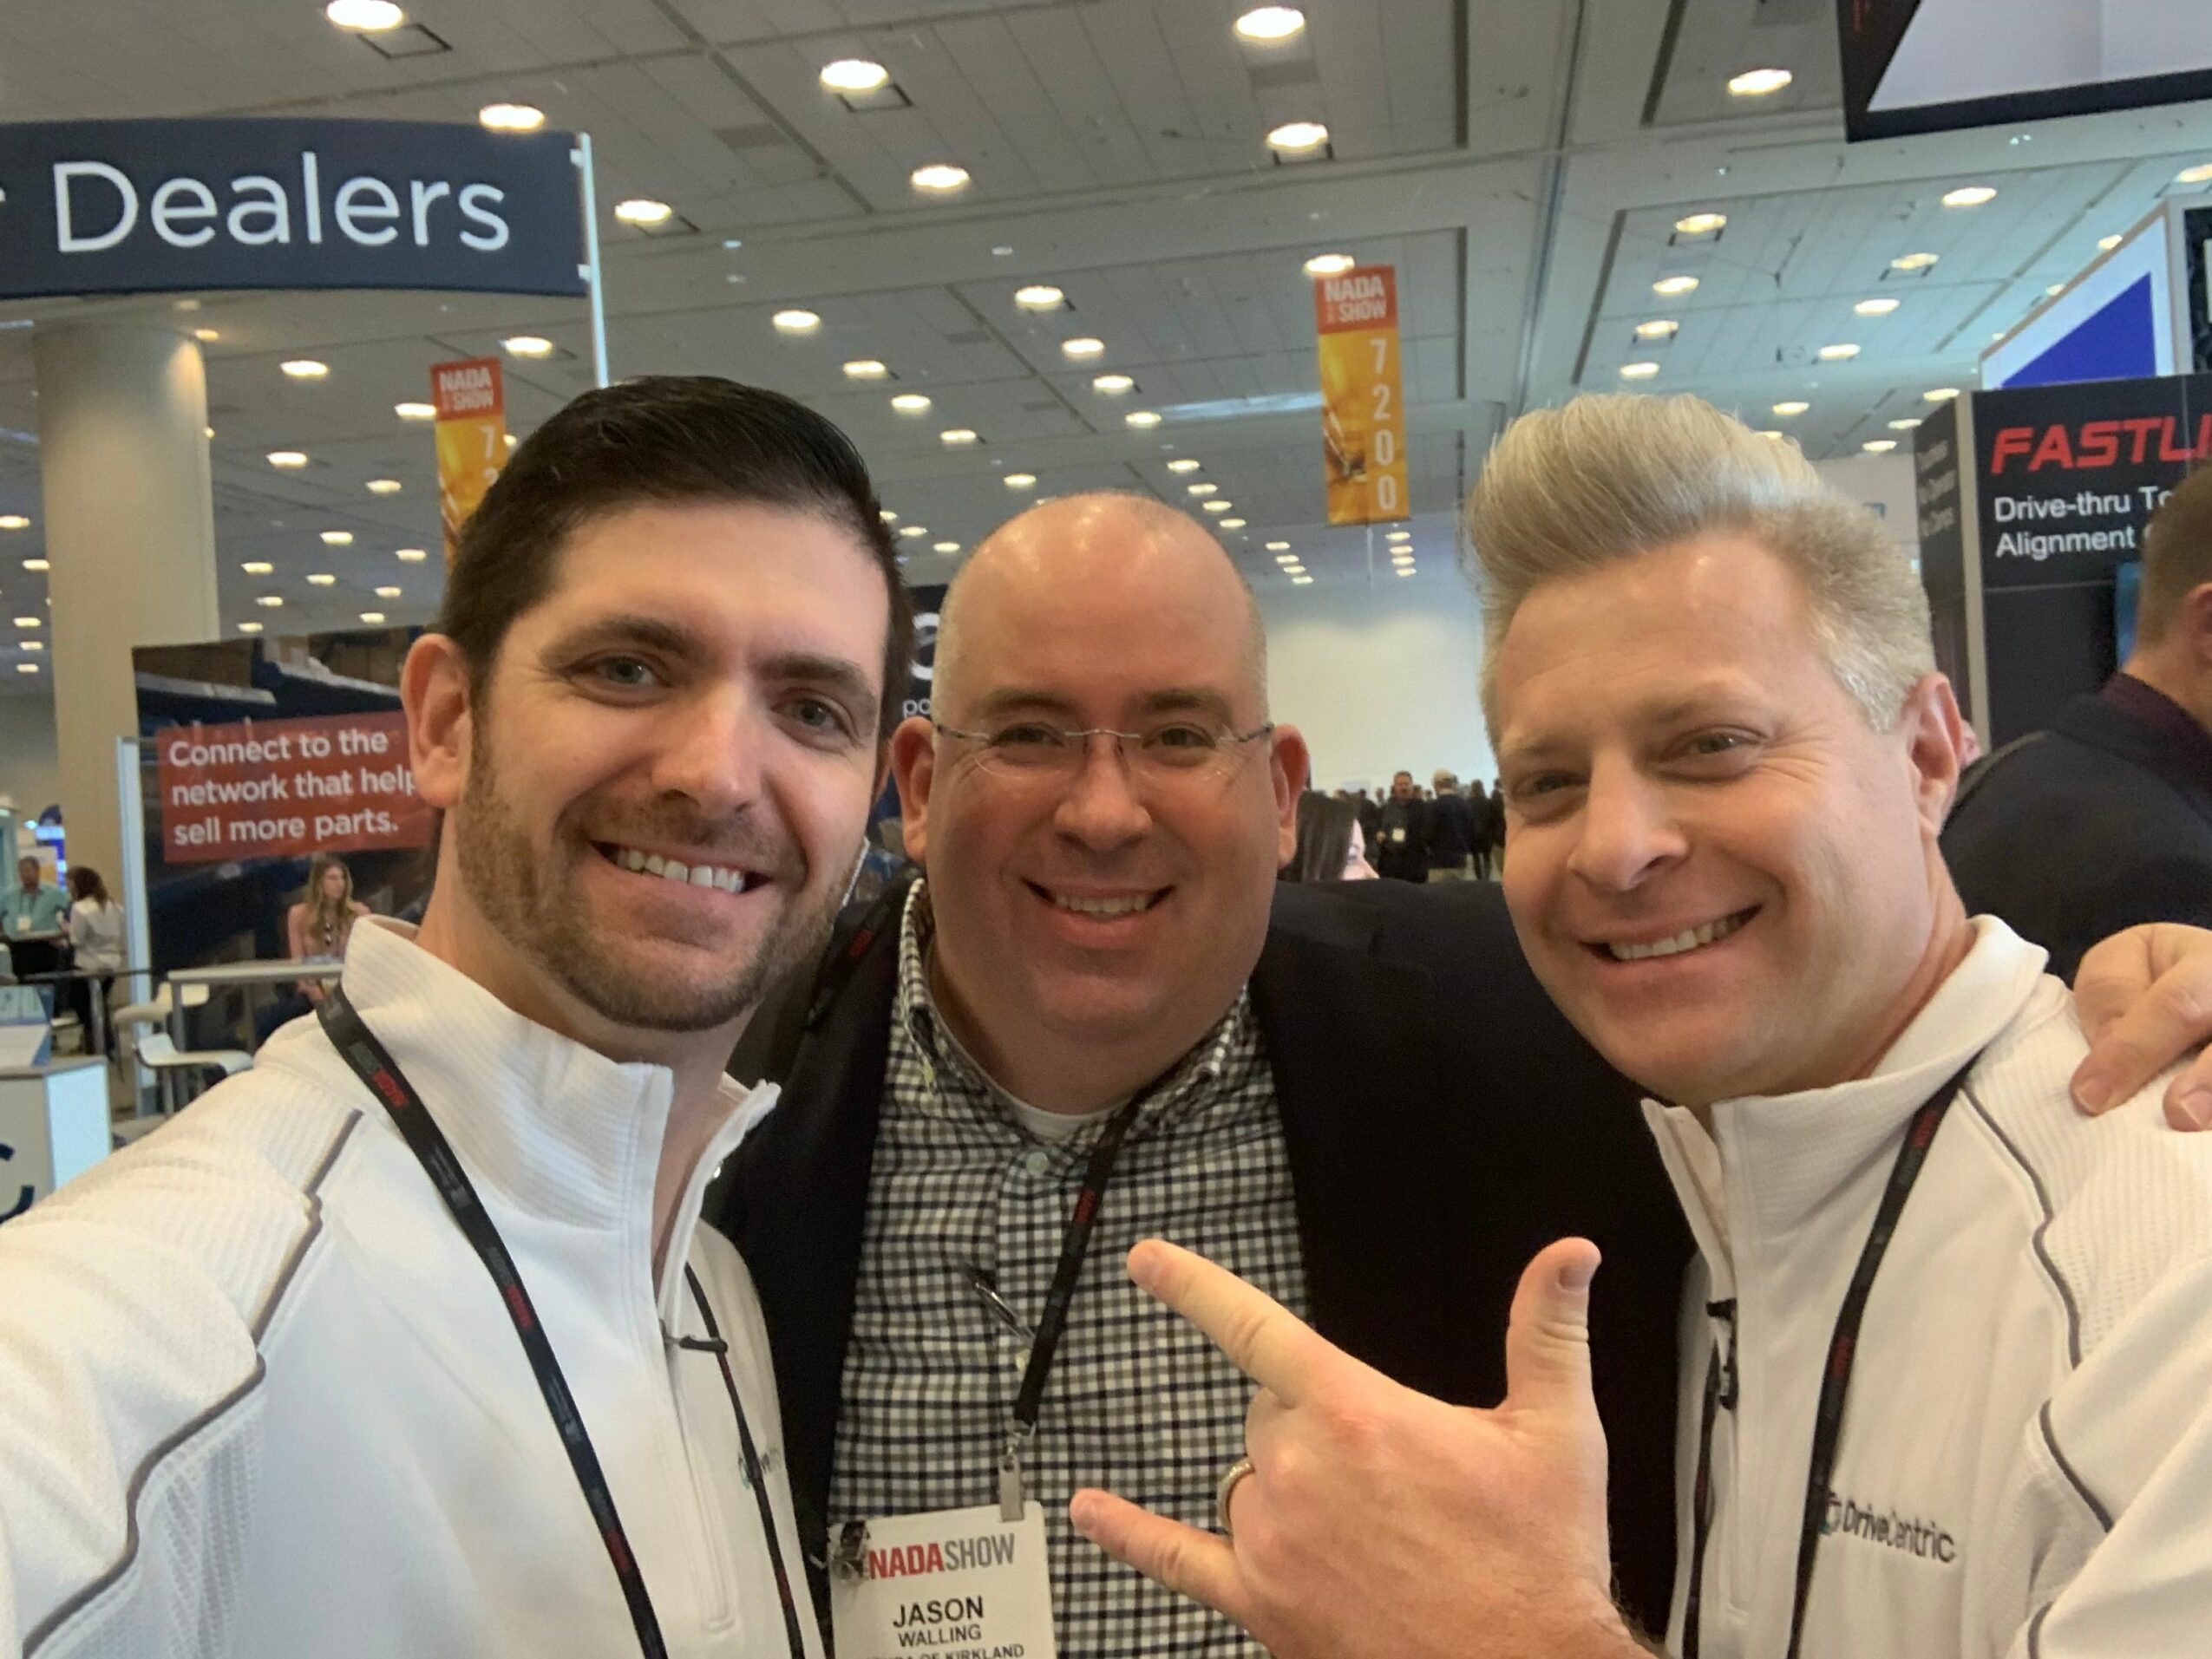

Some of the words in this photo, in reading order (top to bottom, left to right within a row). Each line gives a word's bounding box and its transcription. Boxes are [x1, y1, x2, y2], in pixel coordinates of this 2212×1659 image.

[53, 151, 510, 251] Dealers
[1324, 274, 1385, 302] NADA
[1339, 298, 1386, 322] SHOW
[439, 367, 492, 391] NADA
[1995, 490, 2130, 521] Drive-thru
[1996, 526, 2136, 561] Alignment
[169, 735, 291, 767] Connect
[299, 735, 330, 758] to
[338, 728, 389, 754] the
[173, 774, 289, 806] network
[295, 769, 353, 798] that
[174, 816, 220, 846] sell
[229, 817, 305, 841] more
[315, 808, 399, 841] parts.
[893, 1595, 984, 1628] JASON
[898, 1623, 982, 1647] WALLING
